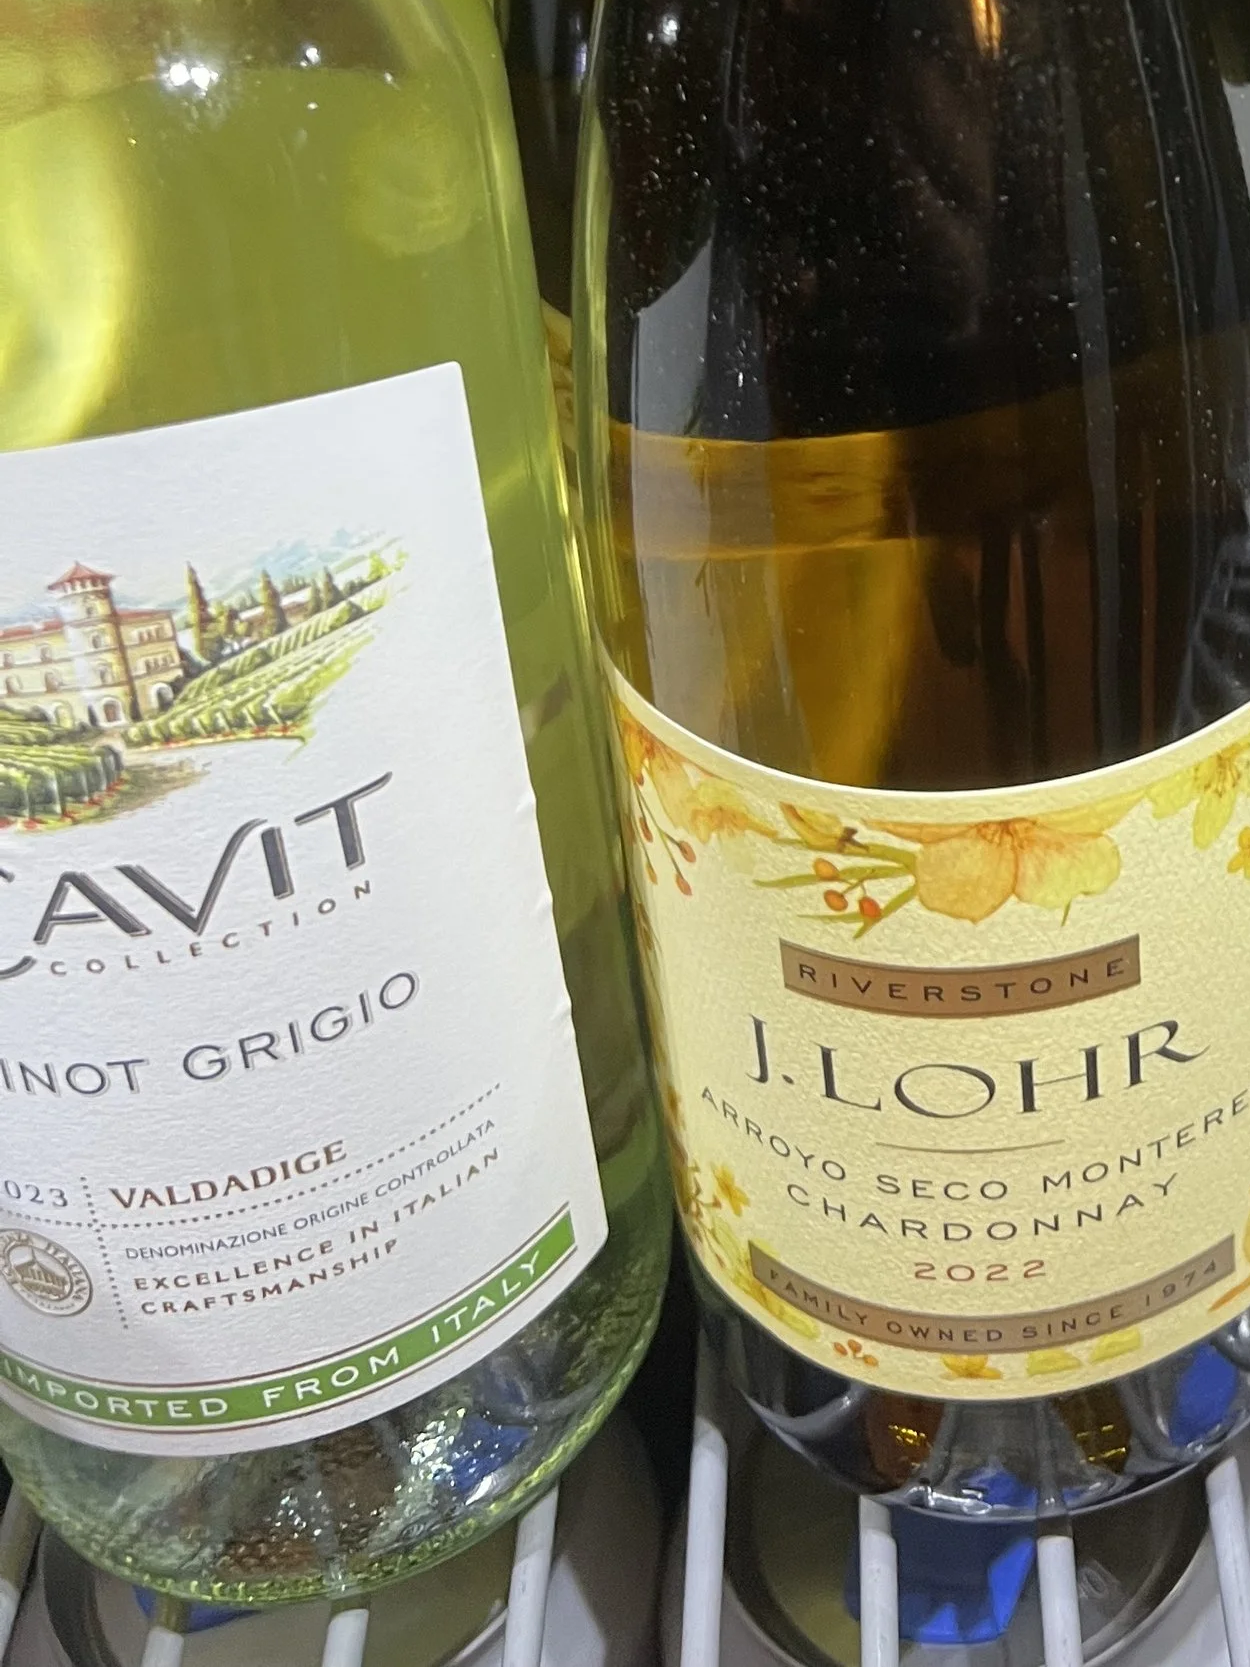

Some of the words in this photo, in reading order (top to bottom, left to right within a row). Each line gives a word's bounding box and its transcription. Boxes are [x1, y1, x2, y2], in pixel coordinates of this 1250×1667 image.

[50, 879, 372, 975] COLLECTION
[798, 958, 1126, 1003] RIVERSTONE
[183, 971, 419, 1081] GRIGIO
[109, 1139, 348, 1209] VALDADIGE
[700, 1086, 847, 1182] ARROYO
[877, 1174, 1008, 1201] SECO
[126, 1222, 289, 1260] DENOMINAZIONE
[293, 1192, 369, 1231] ORIGINE
[375, 1118, 495, 1199] CONTROLLATA
[134, 1240, 333, 1292] EXCELLENCE
[350, 1219, 380, 1244] IN
[393, 1147, 499, 1222] ITALIAN
[787, 1172, 1177, 1242] CHARDONNAY
[141, 1237, 398, 1315] CRAFTSMANSHIP
[770, 1268, 868, 1327] FAMILY
[886, 1320, 1003, 1343] OWNED
[1022, 1304, 1124, 1339] SINCE
[1144, 1259, 1218, 1308] 1974
[914, 1260, 1046, 1283] 2022
[3, 1357, 229, 1419] IMPORTED
[263, 1346, 400, 1409] FROM
[432, 1249, 542, 1345] ITALY
